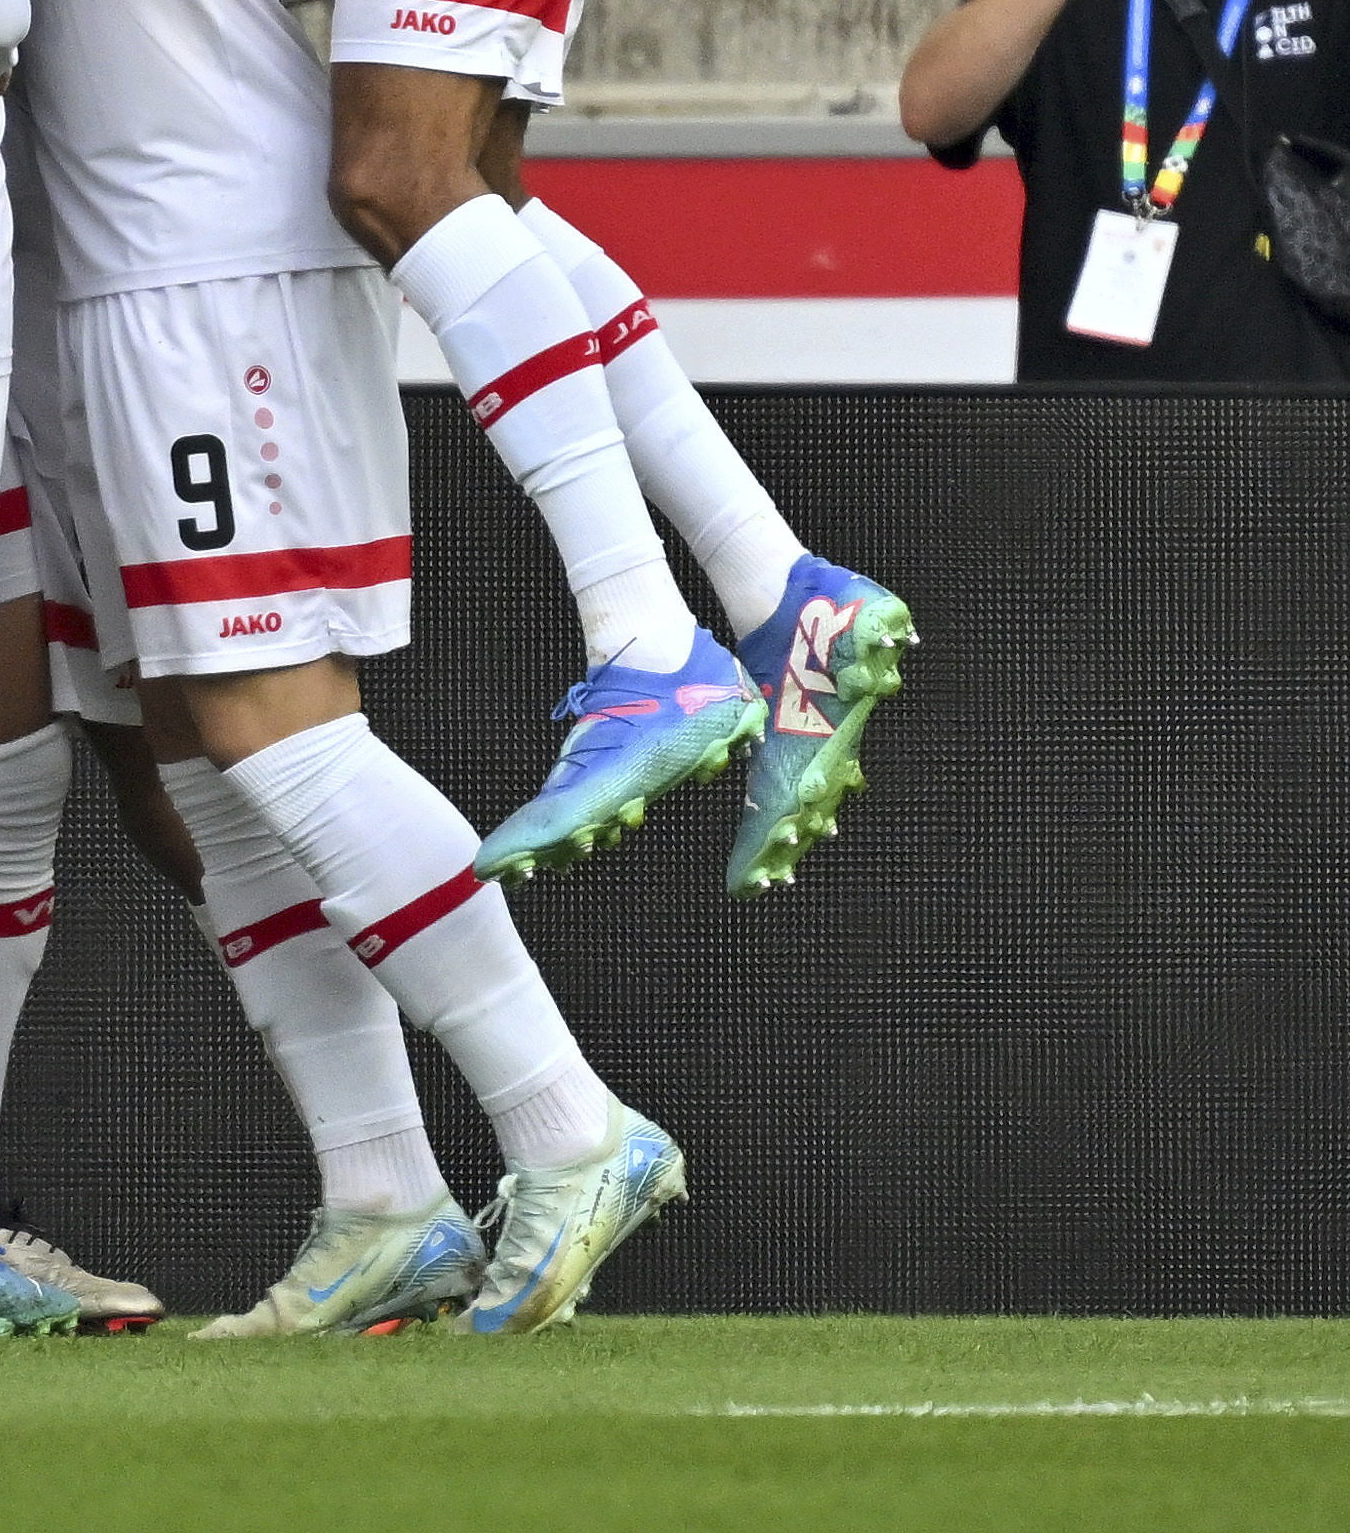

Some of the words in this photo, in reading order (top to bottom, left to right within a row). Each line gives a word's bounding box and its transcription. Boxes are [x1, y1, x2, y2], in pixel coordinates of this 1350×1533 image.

[390, 8, 457, 36] JAKO
[170, 433, 236, 551] 9
[219, 612, 282, 639] JAKO
